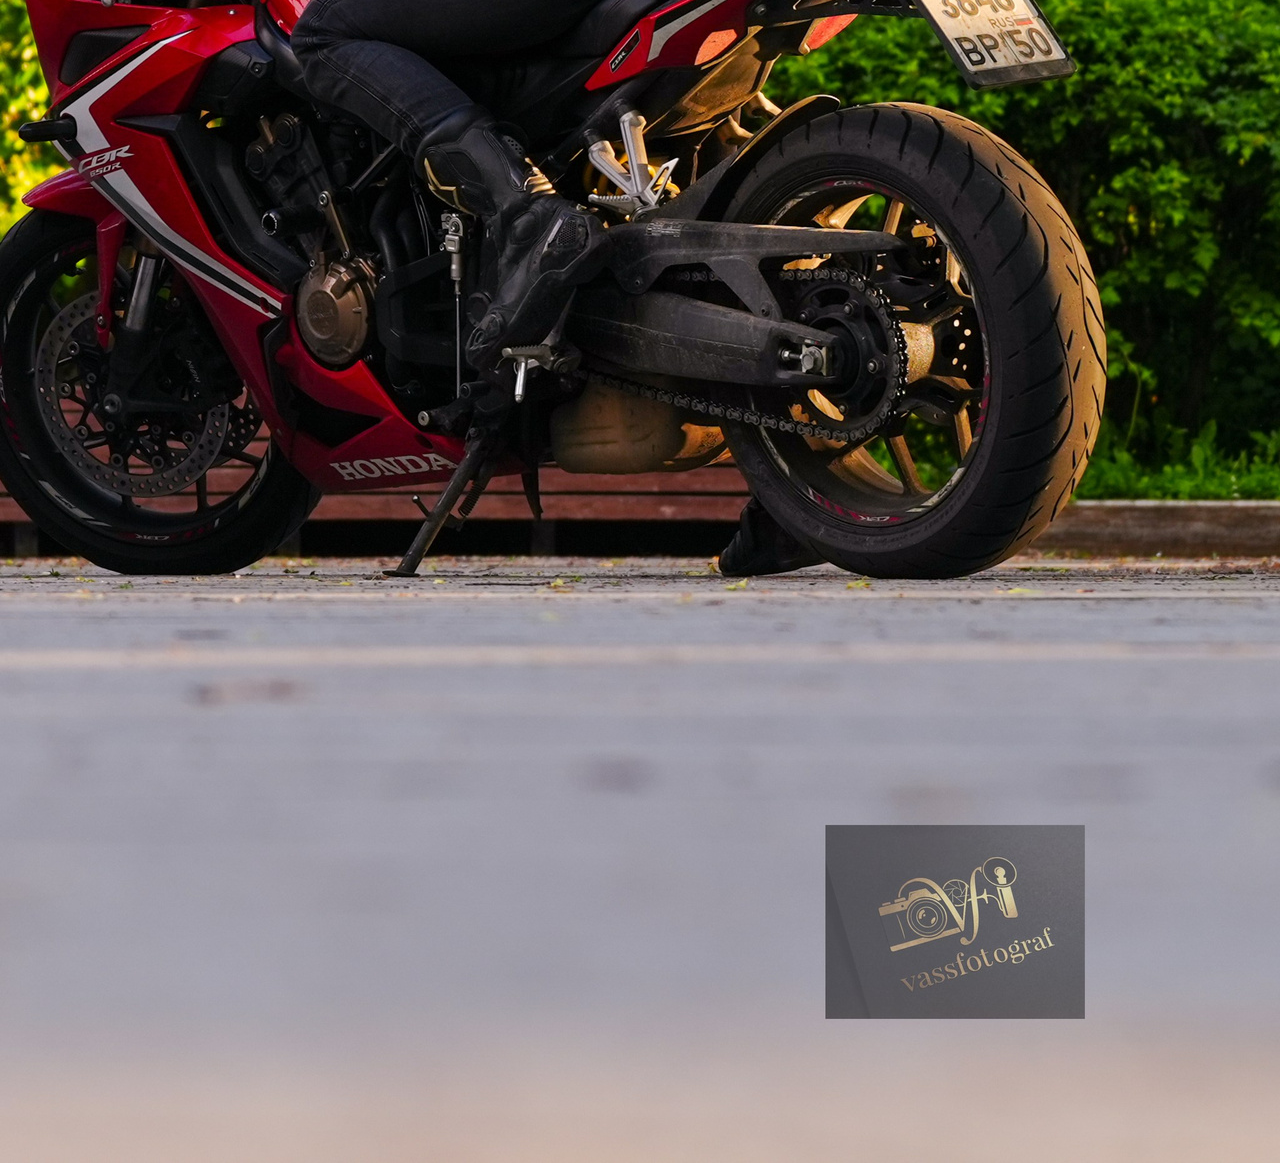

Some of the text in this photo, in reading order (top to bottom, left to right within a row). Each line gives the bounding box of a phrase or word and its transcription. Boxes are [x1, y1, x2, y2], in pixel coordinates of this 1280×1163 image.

[989, 17, 1015, 29] RUS
[1005, 27, 1053, 60] 50
[78, 144, 135, 174] CBR
[89, 162, 122, 178] 650R
[329, 453, 458, 481] HONDA
